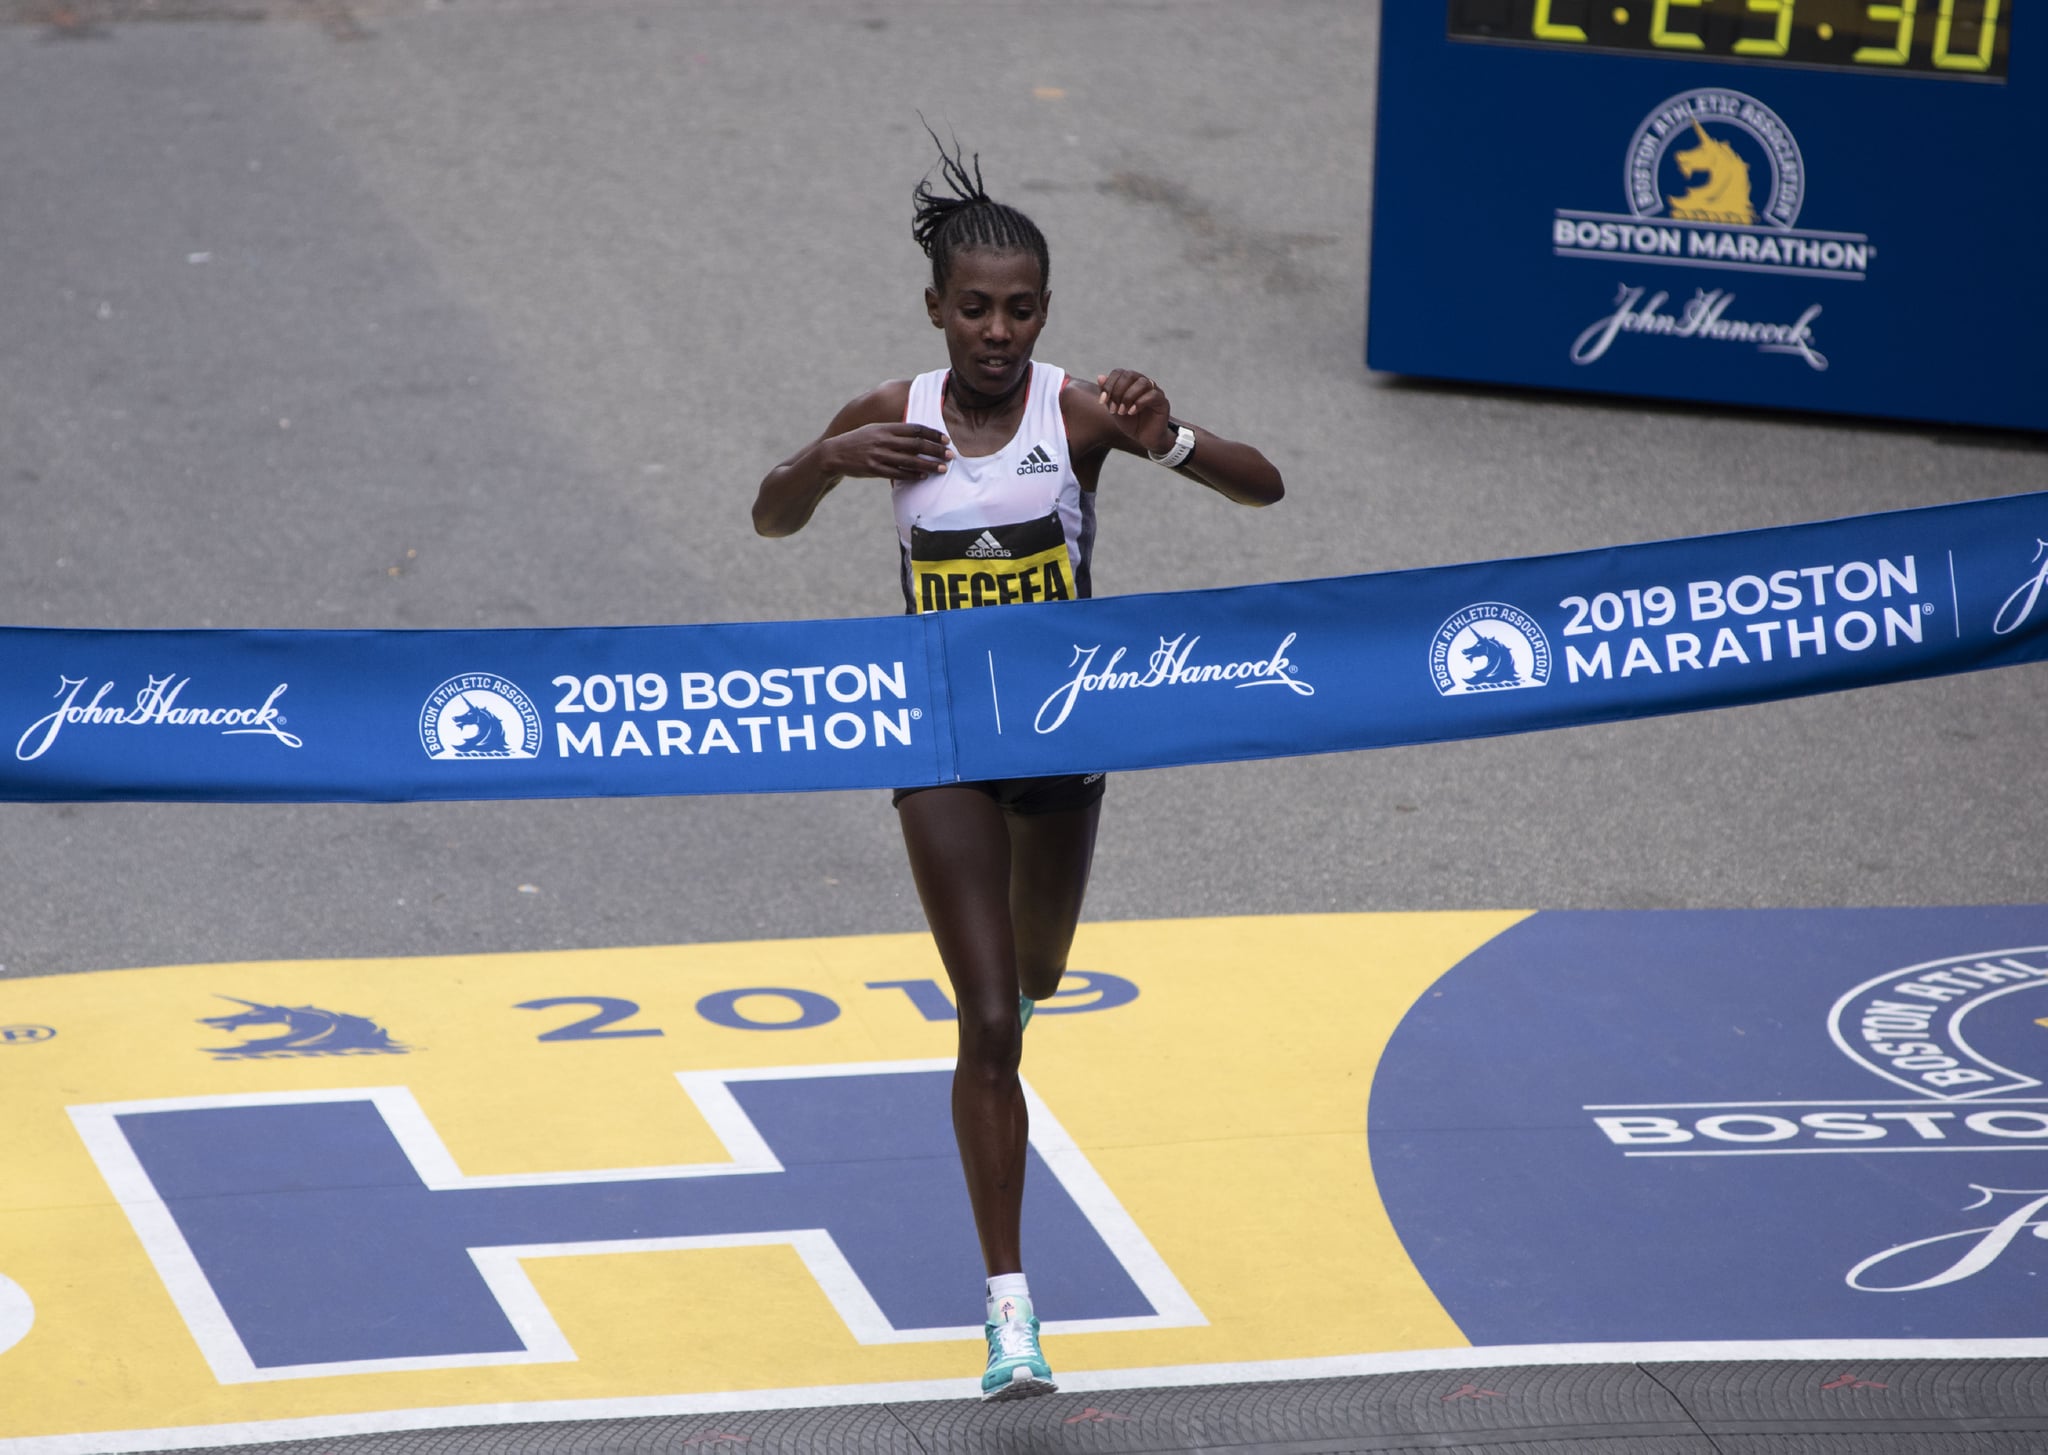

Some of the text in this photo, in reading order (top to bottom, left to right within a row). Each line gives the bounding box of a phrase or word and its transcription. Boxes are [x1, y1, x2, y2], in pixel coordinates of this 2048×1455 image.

[1632, 94, 1800, 220] BOSTON ATHLETIC ASSOCIATION
[1554, 219, 1681, 253] BOSTON
[1570, 282, 1678, 366] John
[1016, 463, 1059, 476] adidas
[965, 548, 1012, 558] adidas
[1560, 556, 1917, 636] 2019 BOSTON
[552, 662, 907, 712] 2019 BOSTON
[1433, 606, 1548, 688] BOSTON ATHLETIC ASSOCIATION
[16, 675, 128, 761] John
[424, 677, 538, 752] BOSTON ATHLETIC ASSOCIATION
[1035, 644, 1142, 734] John
[1862, 958, 2048, 1088] BOSTON ATHL
